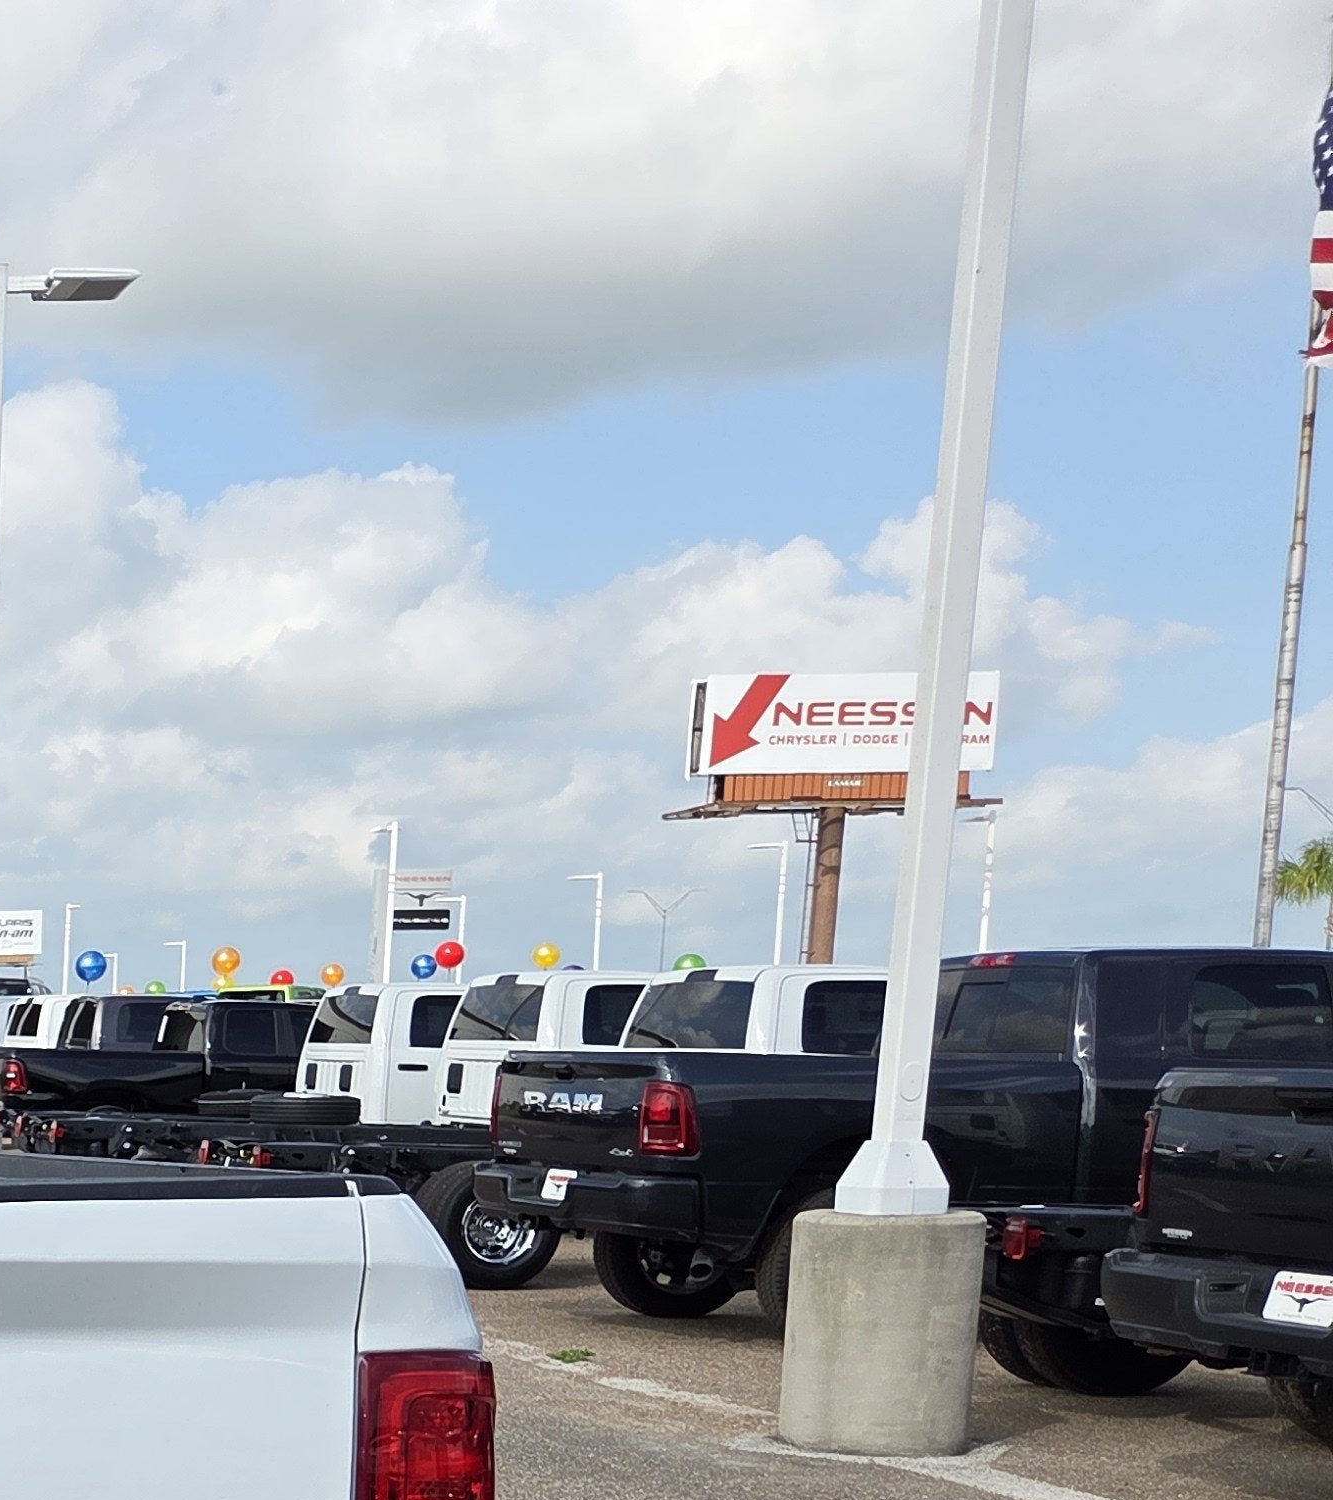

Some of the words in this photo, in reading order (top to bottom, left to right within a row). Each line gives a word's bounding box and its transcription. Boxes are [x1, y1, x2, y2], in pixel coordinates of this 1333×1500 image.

[772, 701, 993, 727] NEESSN
[768, 734, 837, 745] CHRYSLER
[852, 734, 899, 745] DODGE
[961, 734, 990, 744] RAM
[522, 1090, 604, 1114] RAM
[1274, 1280, 1333, 1297] NEESSE
